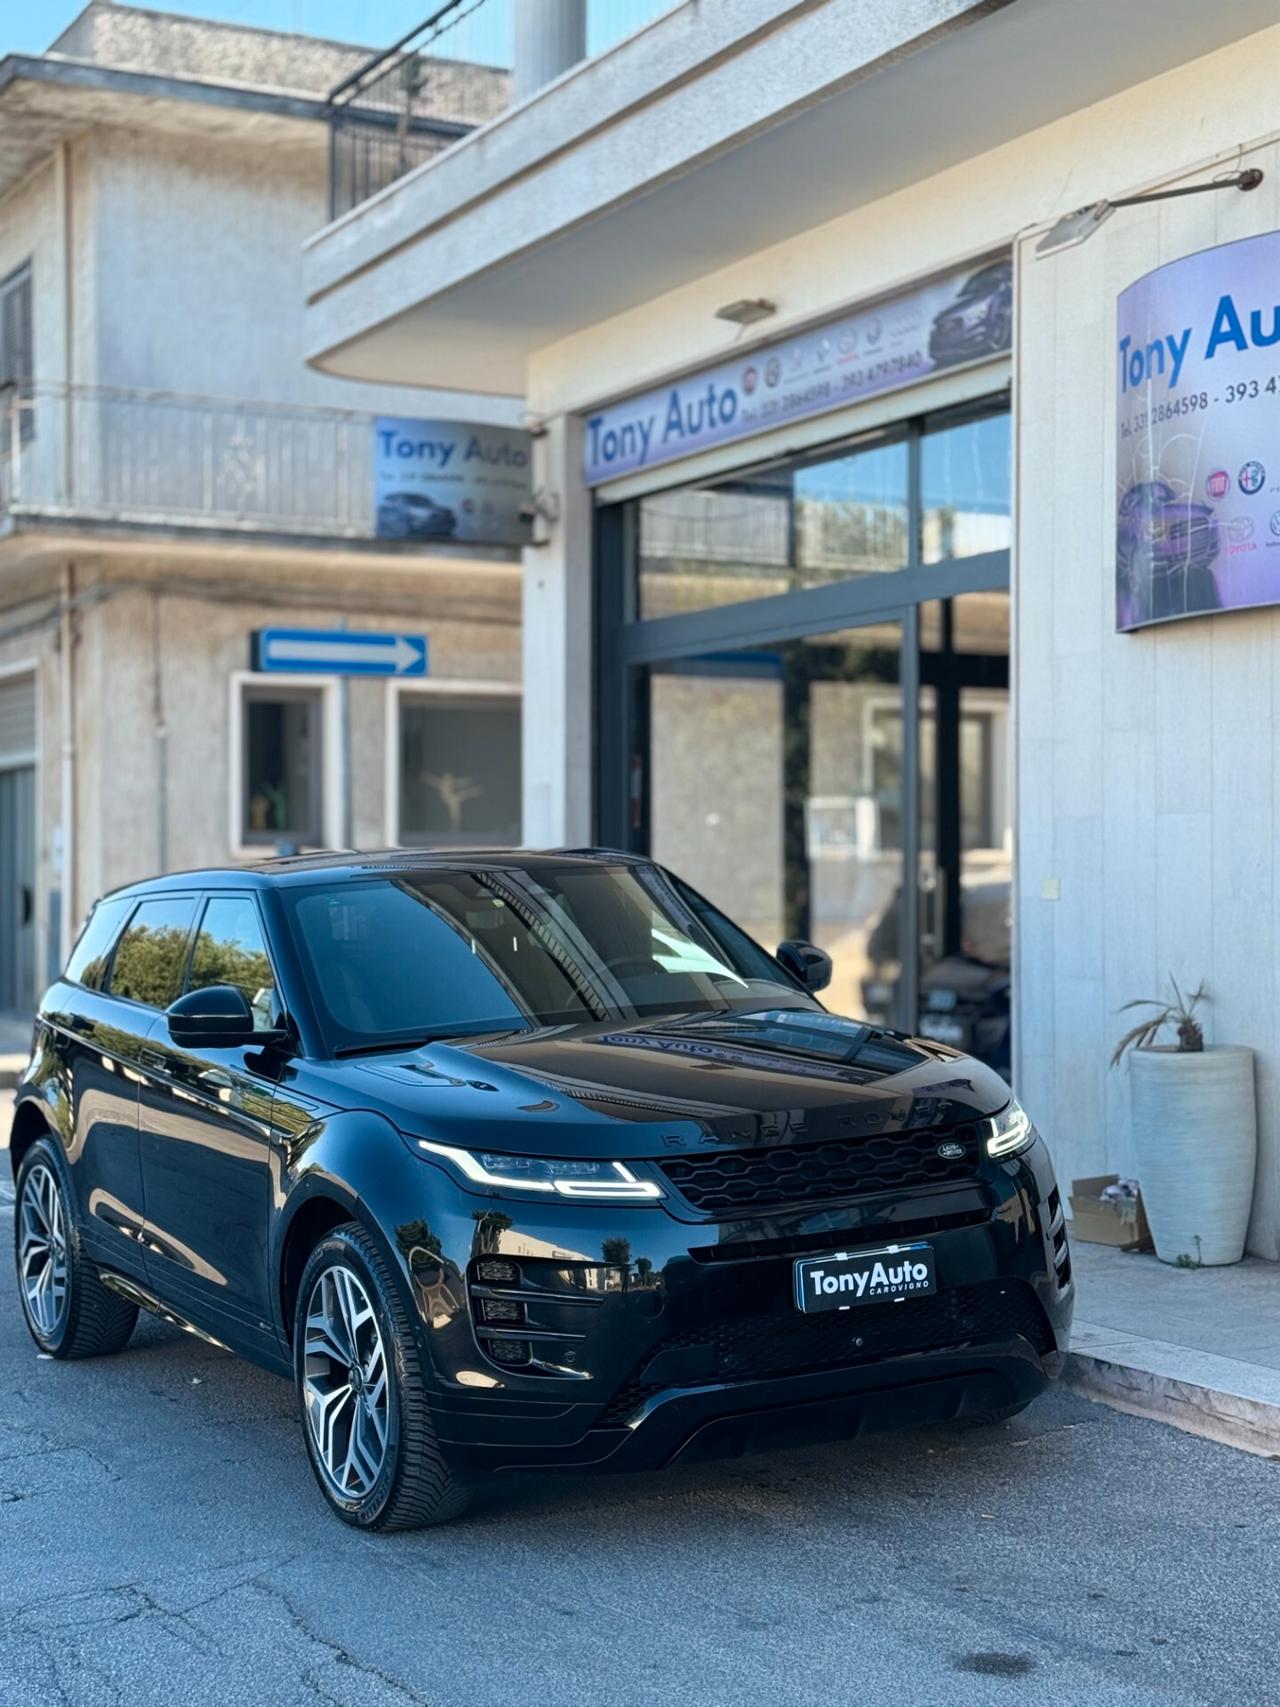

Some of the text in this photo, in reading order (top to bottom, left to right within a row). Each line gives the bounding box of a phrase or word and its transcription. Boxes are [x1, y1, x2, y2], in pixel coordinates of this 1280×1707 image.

[1119, 294, 1280, 393] Tony Au
[1151, 392, 1209, 425] 2864598
[1225, 380, 1259, 404] 393
[587, 383, 737, 466] Tony Auto
[379, 430, 528, 468] Tony Auto
[1224, 542, 1257, 555] TOYOTA
[661, 1121, 809, 1148] RANGE
[810, 1261, 928, 1297] TonyAuto
[869, 1281, 929, 1296] CAROVIGNO
